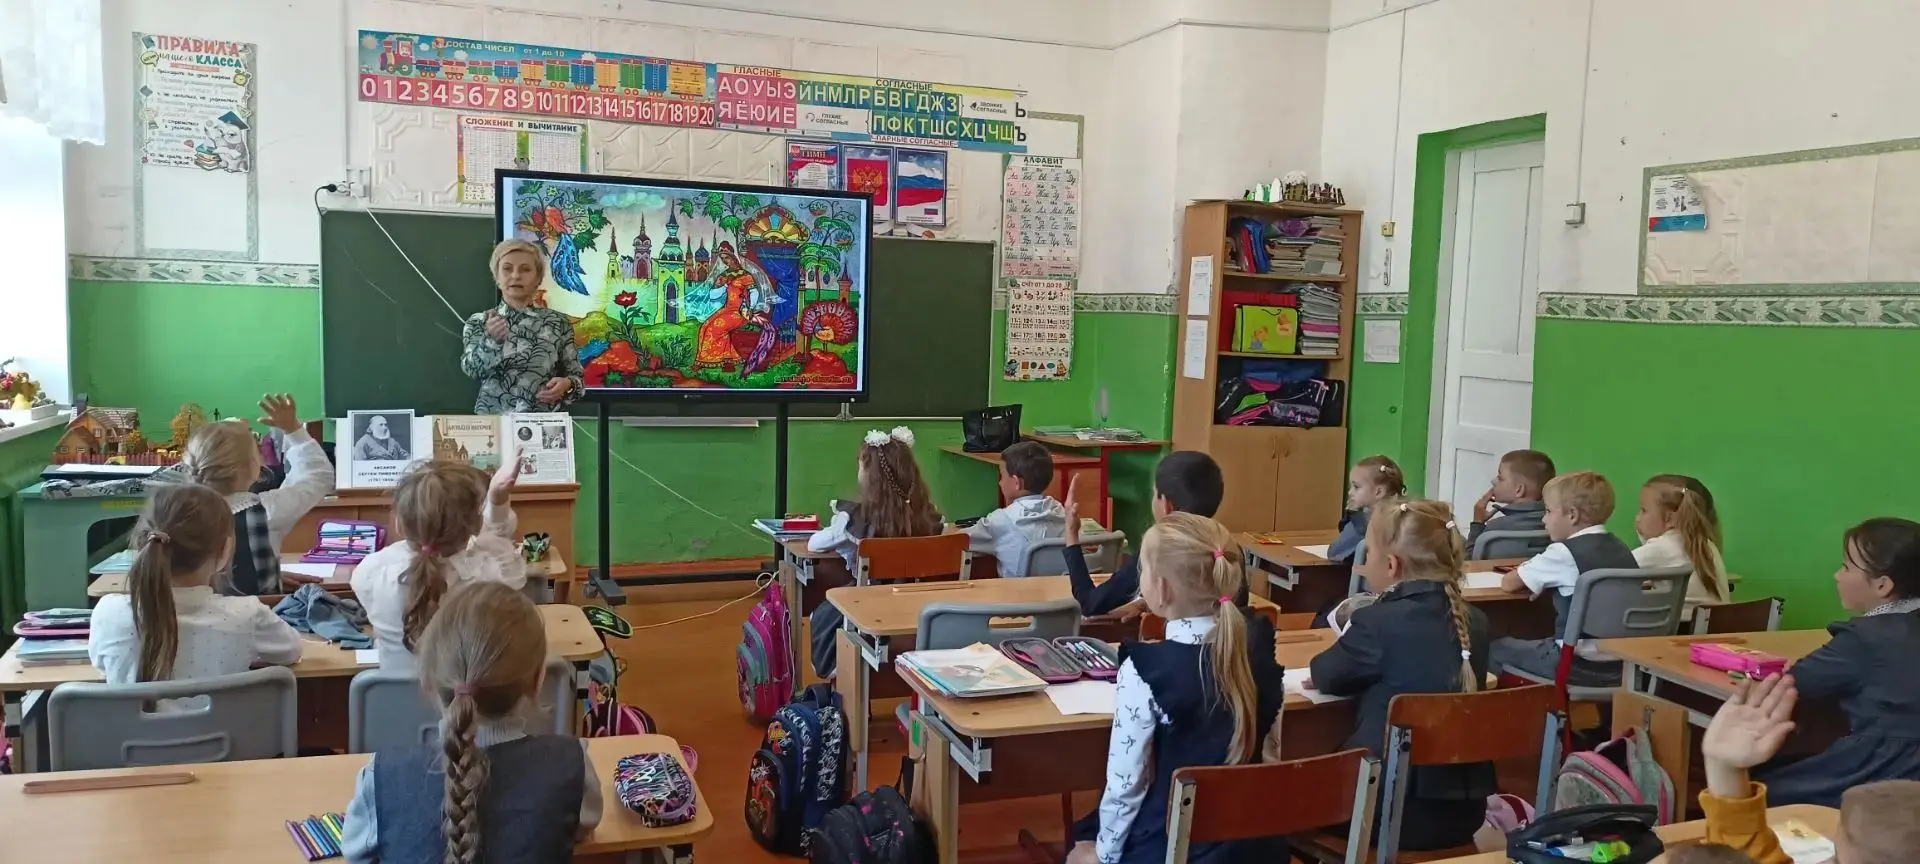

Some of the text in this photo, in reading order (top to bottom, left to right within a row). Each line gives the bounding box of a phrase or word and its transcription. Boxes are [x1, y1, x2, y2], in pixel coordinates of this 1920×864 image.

[157, 36, 239, 57] ПРАВИЛА
[446, 40, 482, 50] СОСТАВ
[484, 44, 515, 53] ЧИСЕЛ
[196, 55, 242, 68] КЛАССА
[733, 66, 782, 77] ГЛАСНЫЕ
[876, 79, 932, 91] СОГЛАСНЫЕ
[362, 78, 714, 126] 0 1 2 3 4 5 6 7 8 9 10 11 12 13 14 15 16 17 18 19 20
[1016, 102, 1026, 118] Ь
[466, 118, 514, 128] СЛОЖЕНИЕ
[528, 122, 578, 132] ВЫЧИТАНИЕ
[1015, 126, 1026, 142] Ъ
[909, 138, 954, 147] СОГЛАСНЫЕ
[1024, 156, 1064, 165] АЛФАВИТ
